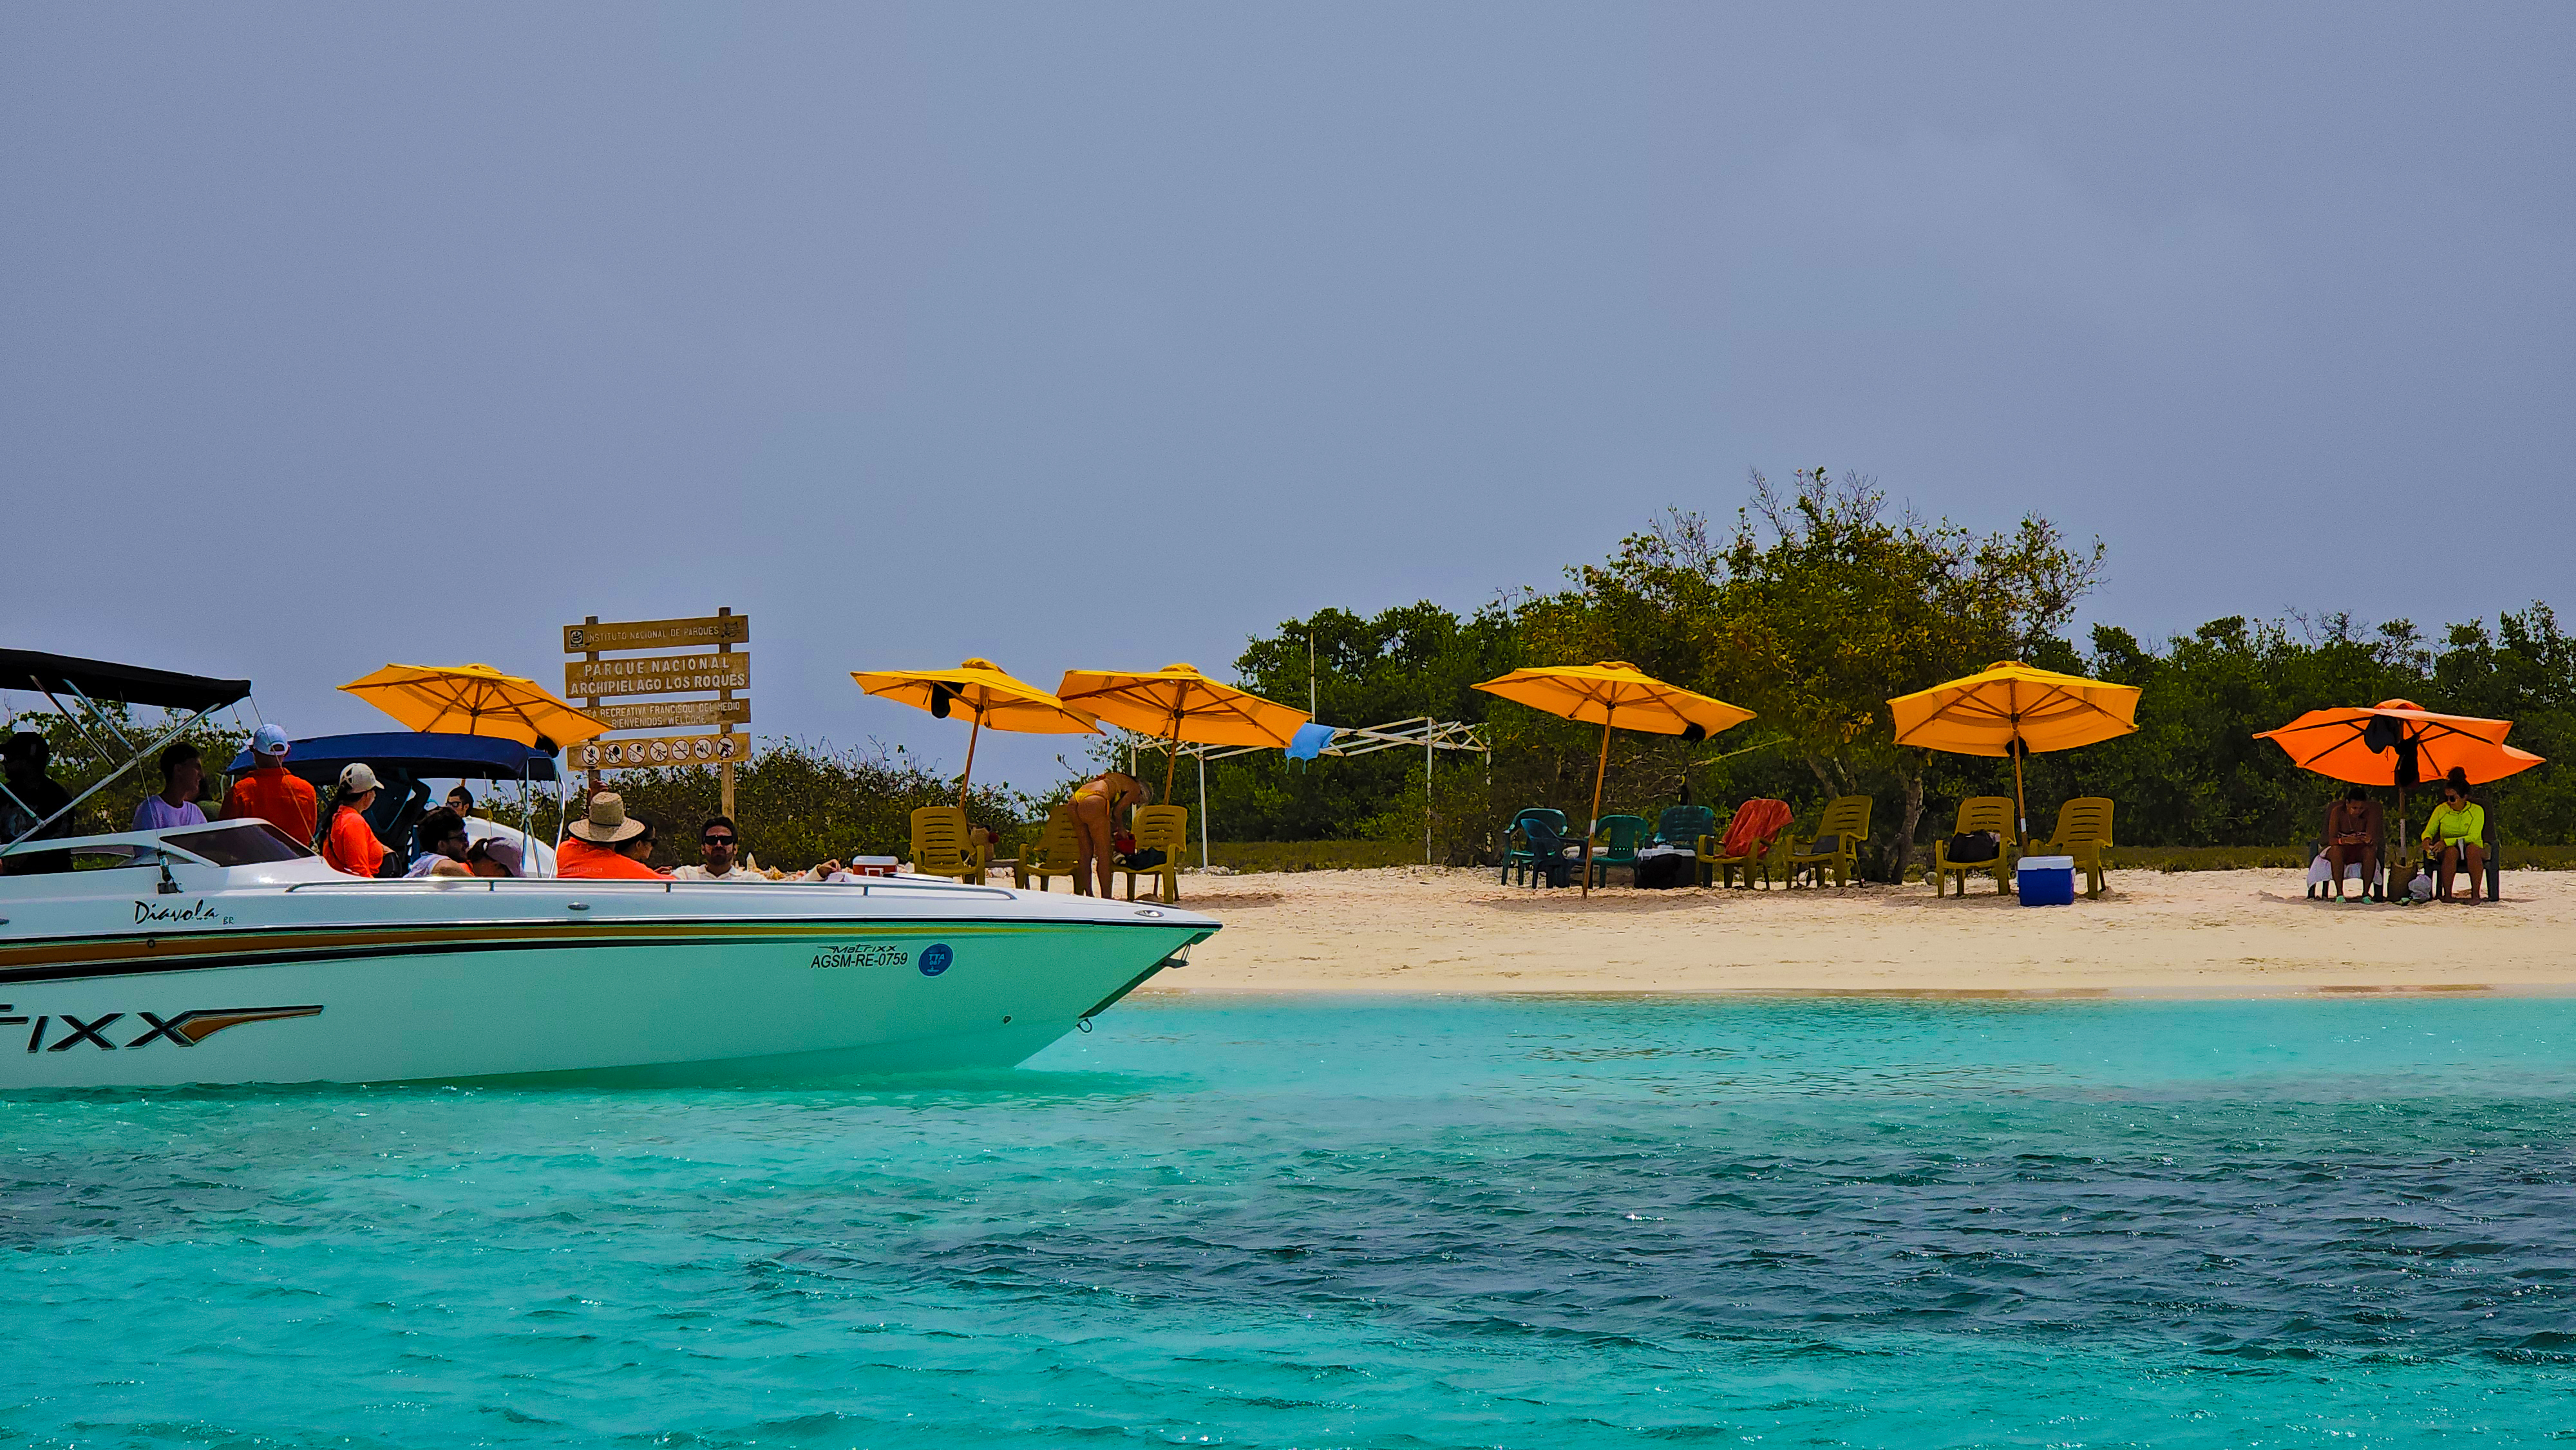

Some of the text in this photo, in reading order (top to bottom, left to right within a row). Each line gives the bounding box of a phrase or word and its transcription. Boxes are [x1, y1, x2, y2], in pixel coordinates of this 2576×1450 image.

[588, 626, 719, 643] INSTITUTO NACIONAL DE PARQUES
[584, 657, 730, 677] PARQUE NACIONAL
[570, 673, 746, 695] ARCHIPIELAGO LOS ROQUES
[600, 706, 647, 719] RECREATIVA
[699, 702, 715, 713] DEL
[717, 701, 740, 711] MEDIO
[611, 715, 707, 729] BIENVENIDOS WELCOME
[134, 899, 220, 925] Diavola
[810, 952, 909, 968] AGSM-RE-0759
